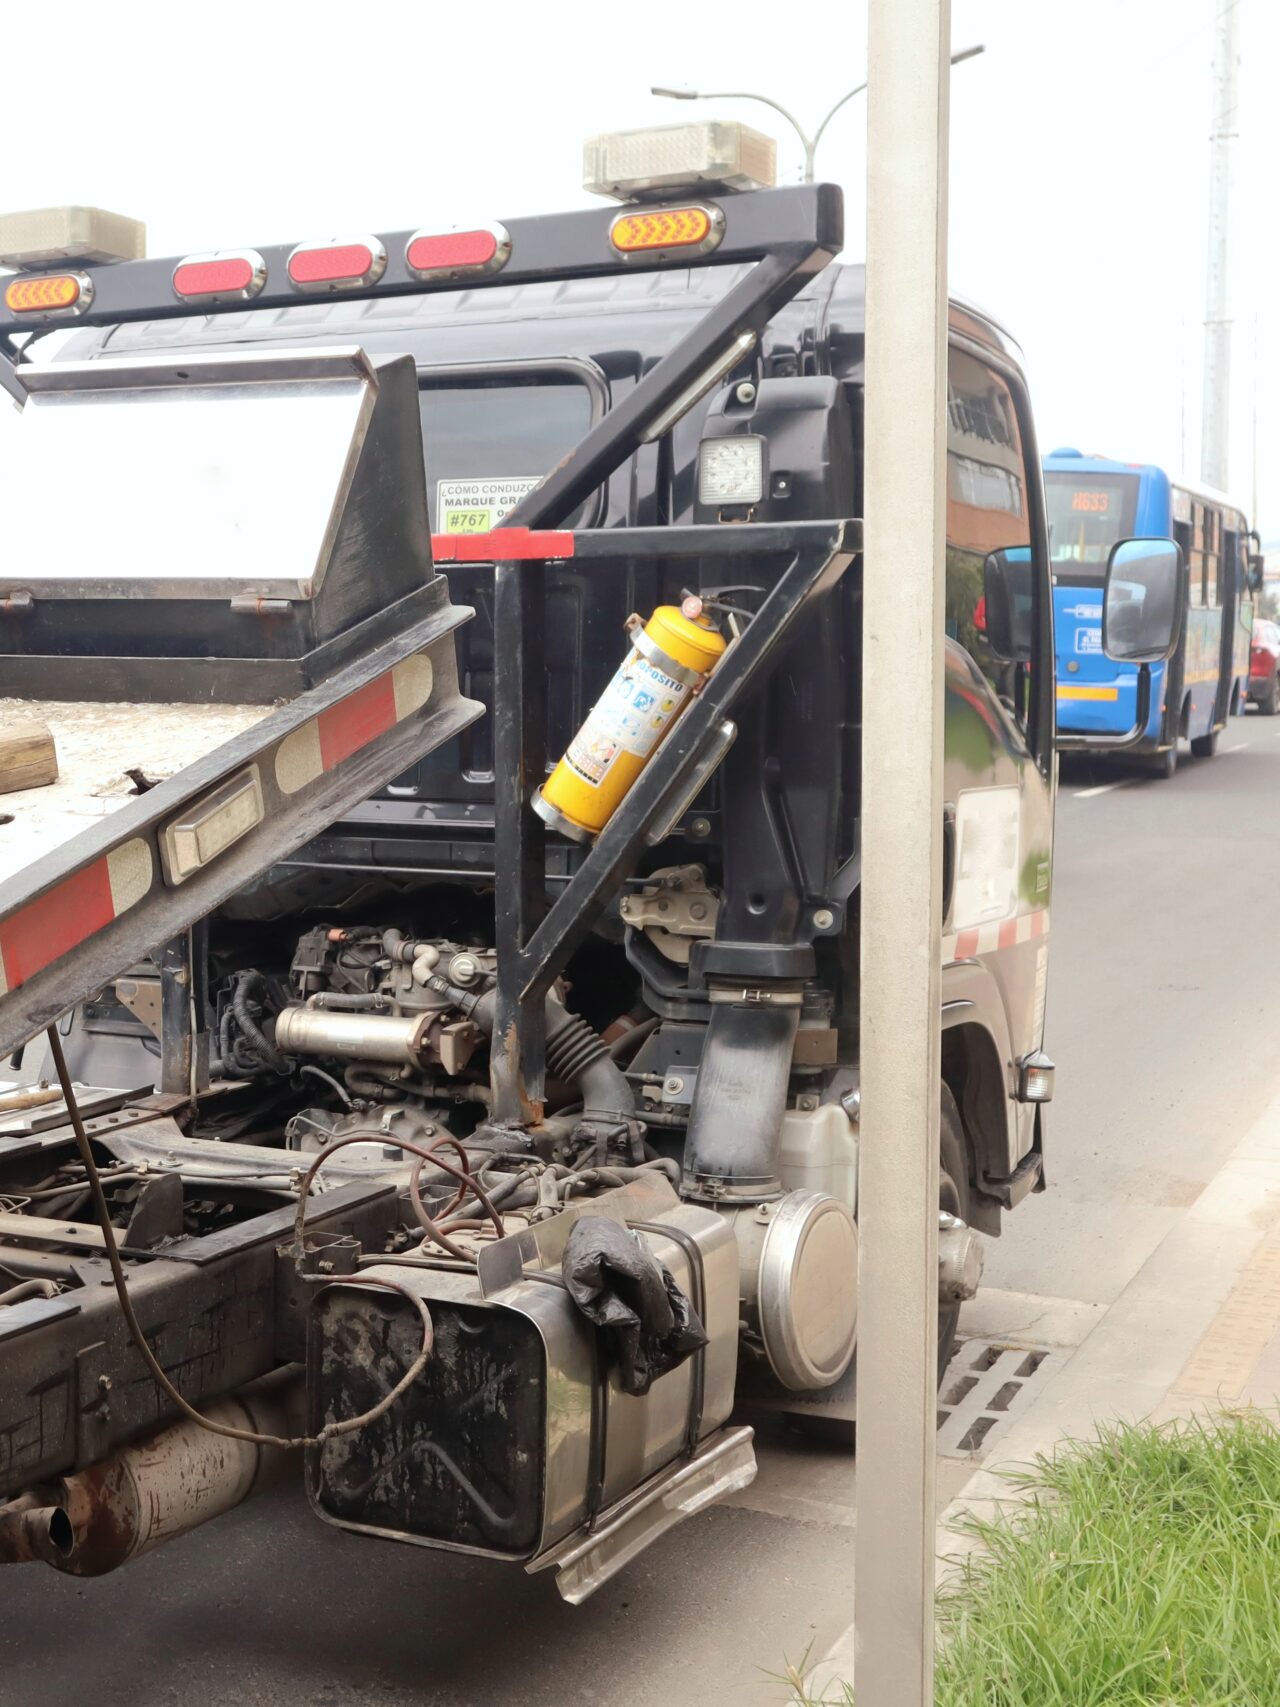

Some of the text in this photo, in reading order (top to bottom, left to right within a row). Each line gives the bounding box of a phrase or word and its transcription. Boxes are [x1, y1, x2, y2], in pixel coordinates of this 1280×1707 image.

[444, 496, 496, 507] MARQUE
[450, 513, 486, 527] #767
[639, 661, 684, 692] OPOSITO
